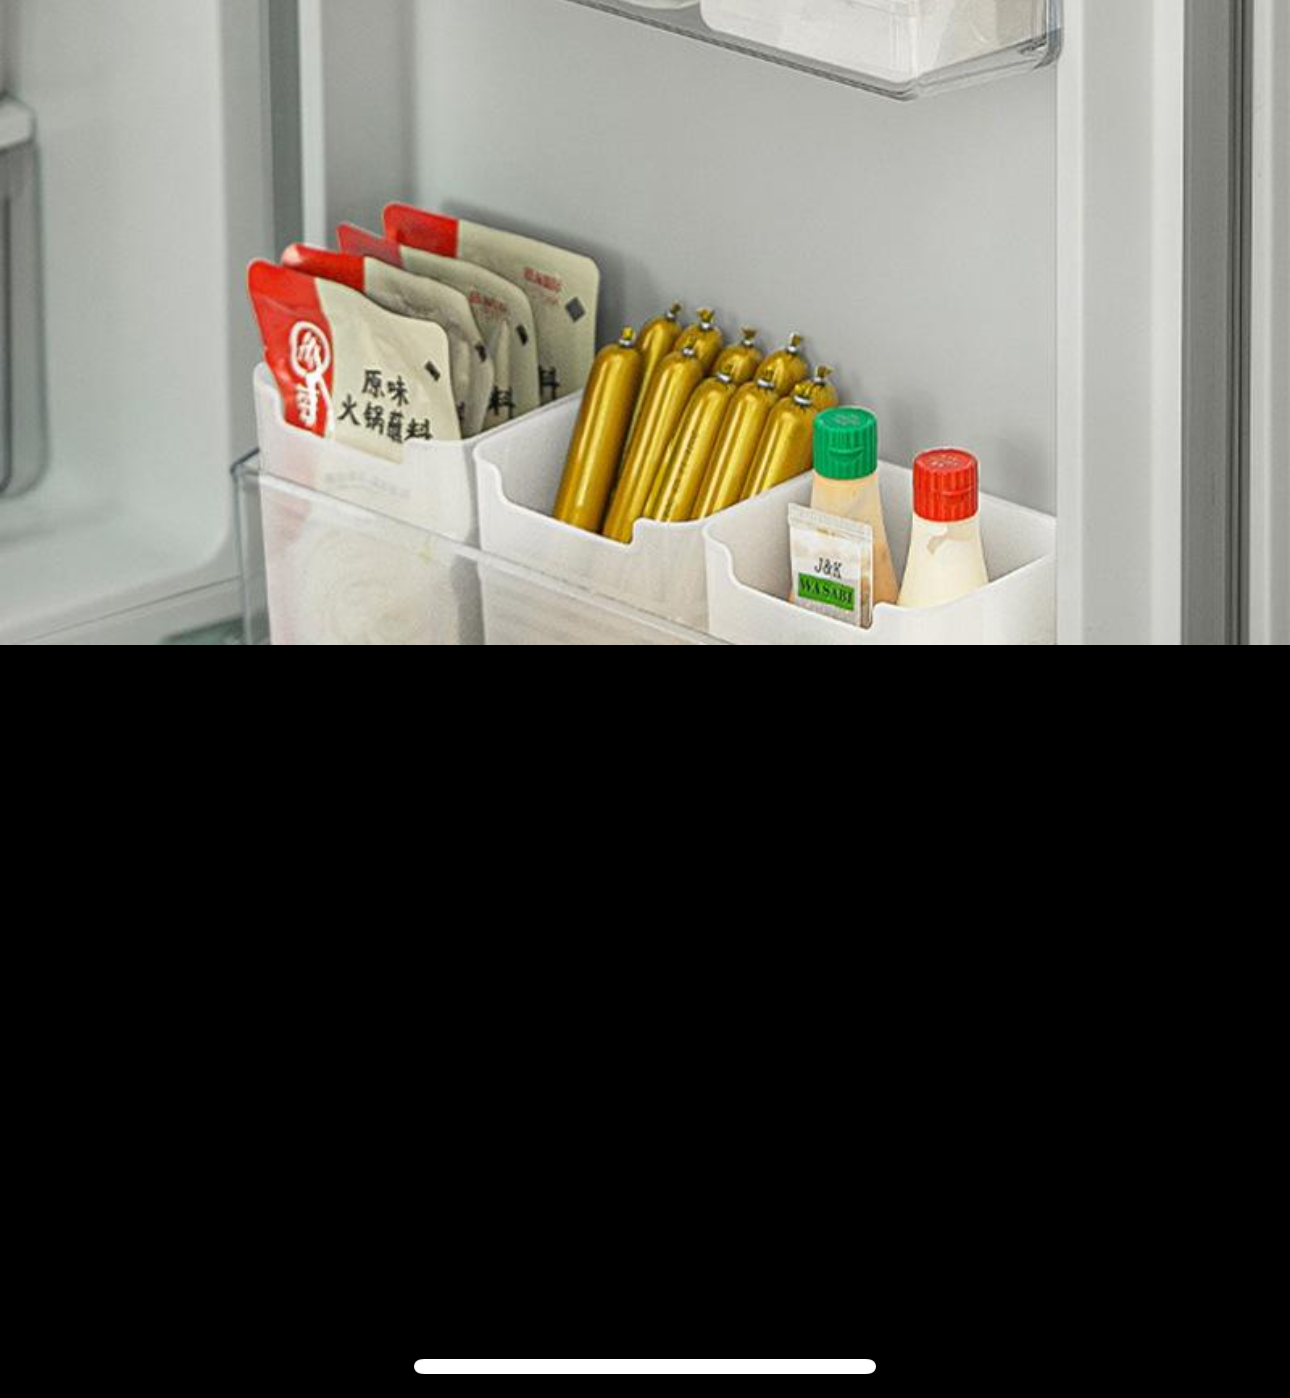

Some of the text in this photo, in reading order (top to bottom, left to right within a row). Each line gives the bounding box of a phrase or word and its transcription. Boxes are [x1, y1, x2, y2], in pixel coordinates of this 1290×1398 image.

[362, 369, 409, 406] 原味
[813, 556, 843, 580] J&K
[800, 578, 854, 604] WASABI
